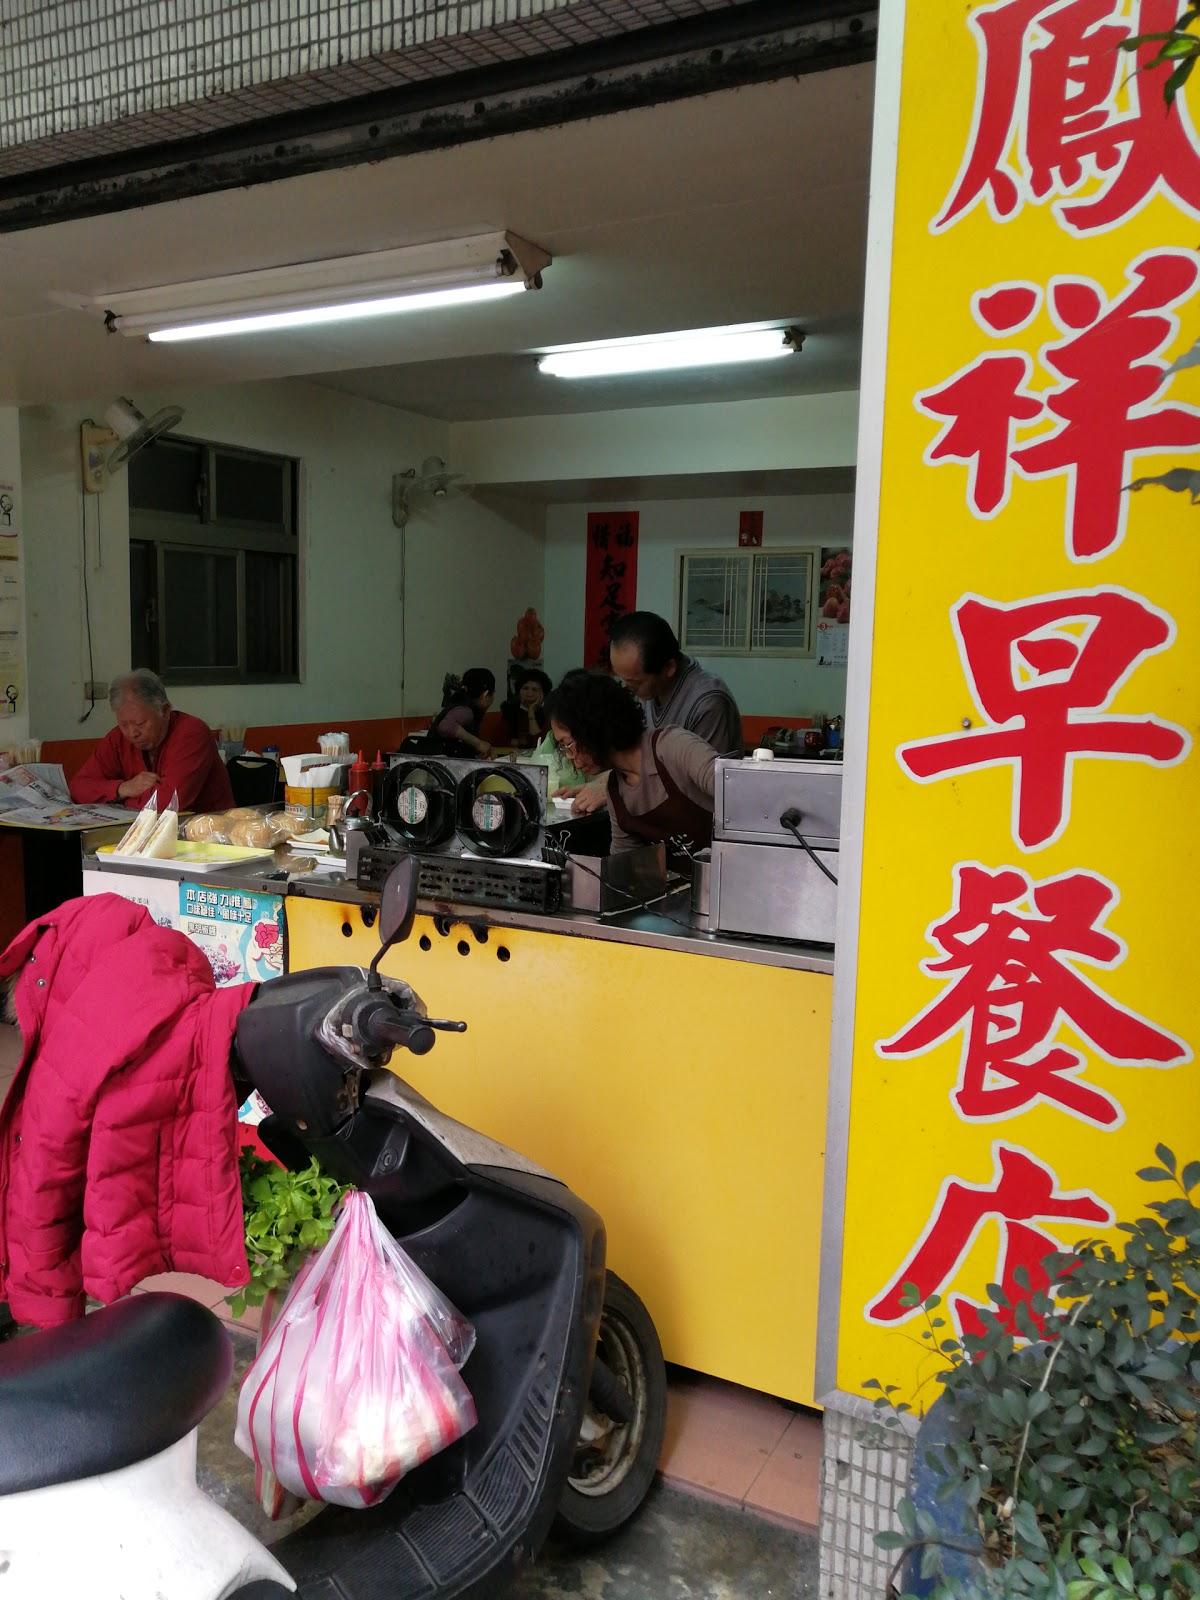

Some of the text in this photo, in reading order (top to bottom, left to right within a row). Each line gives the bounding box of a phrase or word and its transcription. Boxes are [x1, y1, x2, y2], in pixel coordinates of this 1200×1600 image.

[866, 0, 1200, 1350] 鳳祥早餐店
